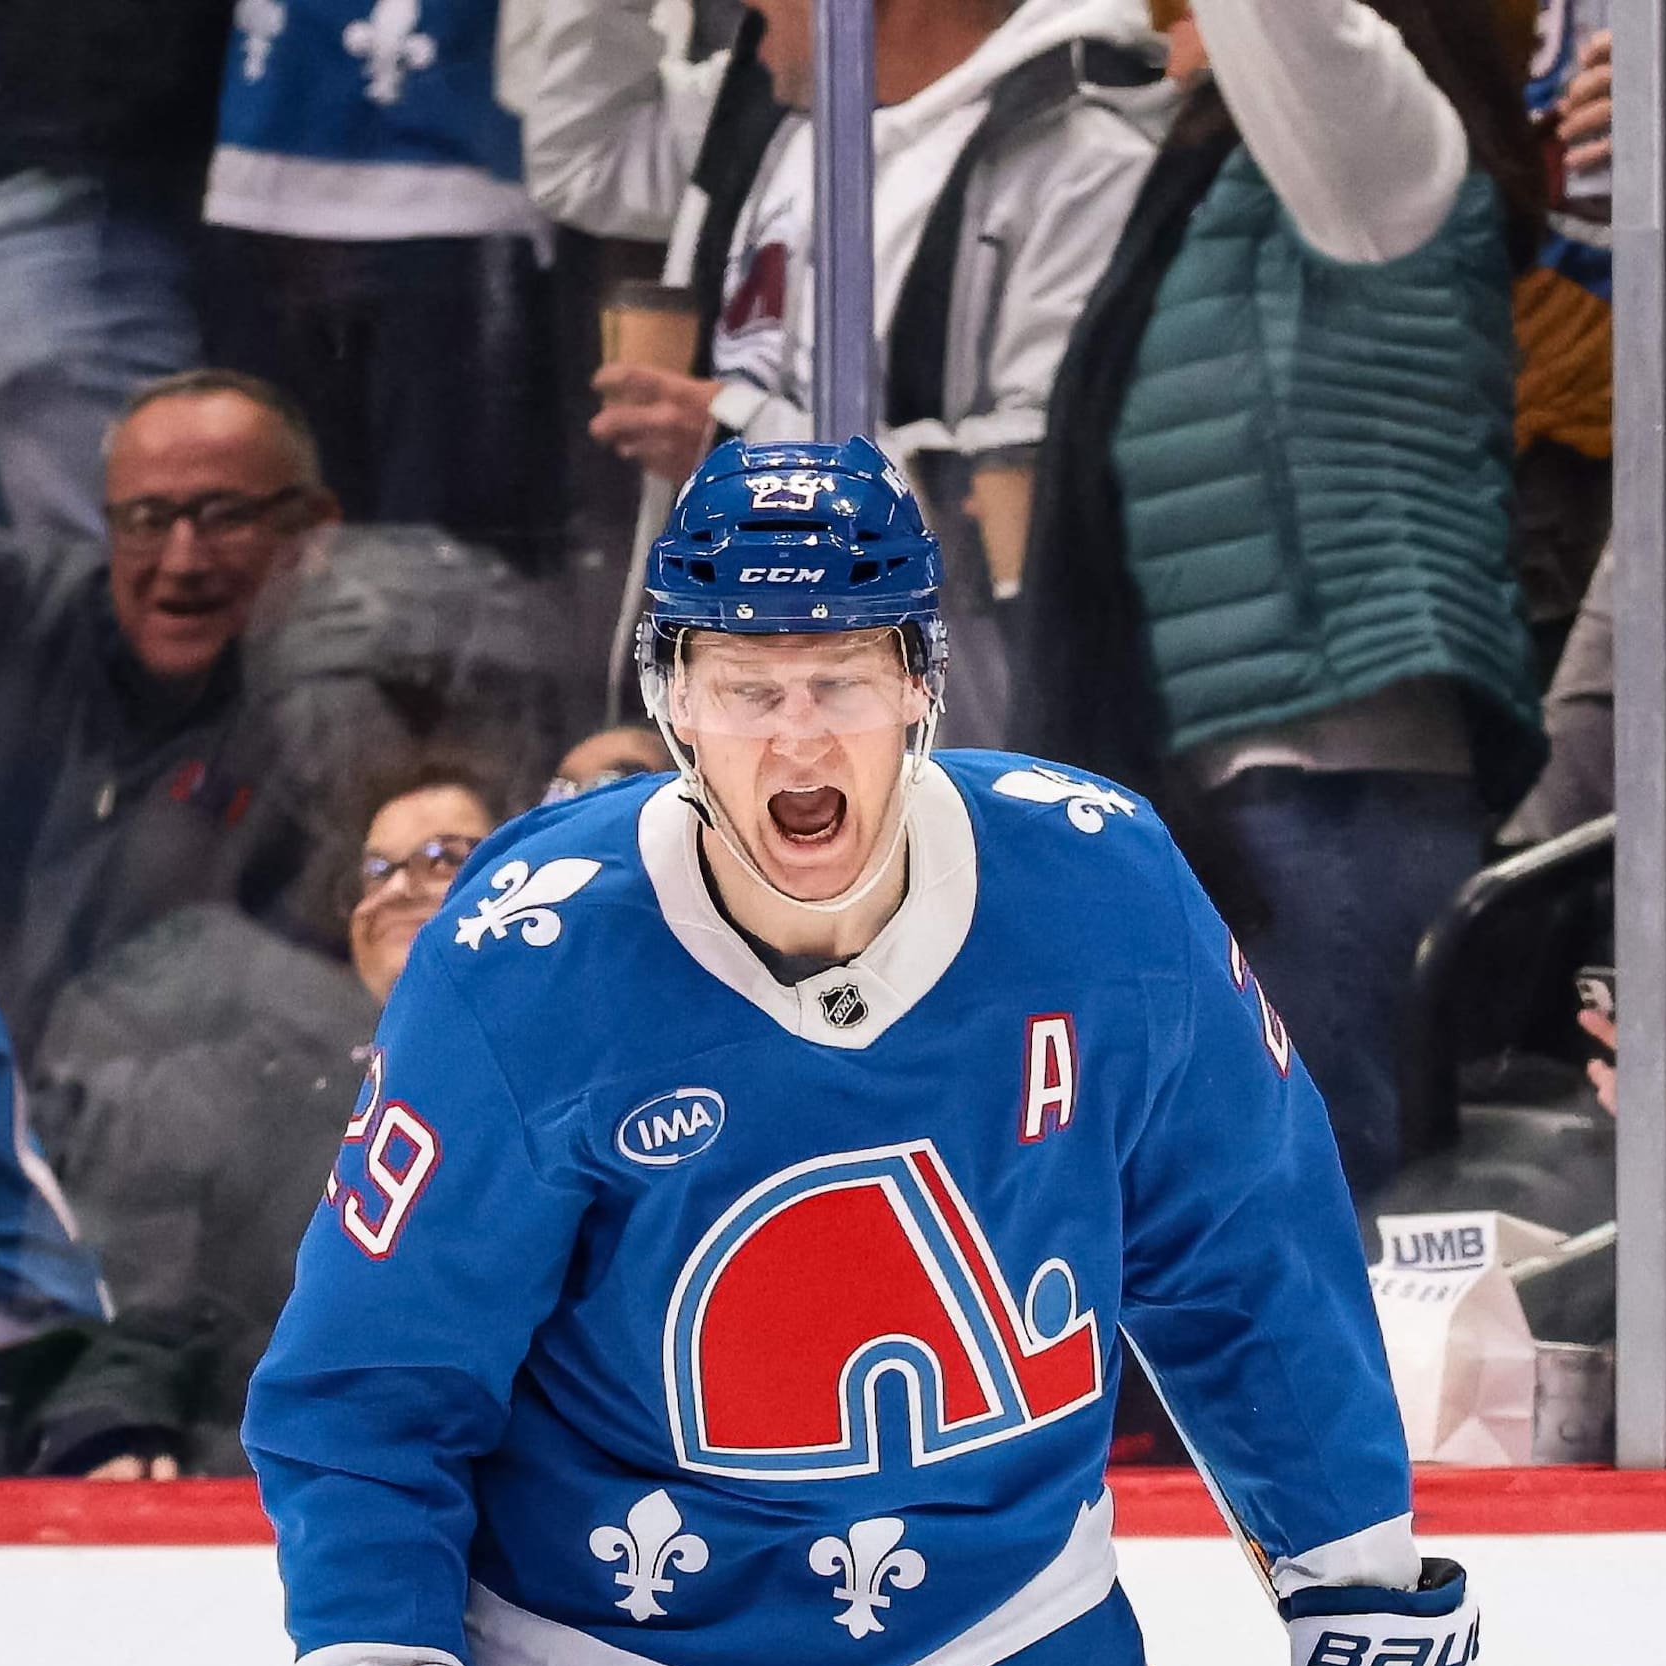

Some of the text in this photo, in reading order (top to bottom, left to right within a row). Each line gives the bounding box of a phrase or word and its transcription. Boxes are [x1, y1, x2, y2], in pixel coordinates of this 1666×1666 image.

[738, 567, 826, 584] CCM
[1019, 1012, 1078, 1144] A
[637, 1101, 714, 1151] IMA
[1393, 1226, 1485, 1265] UMB
